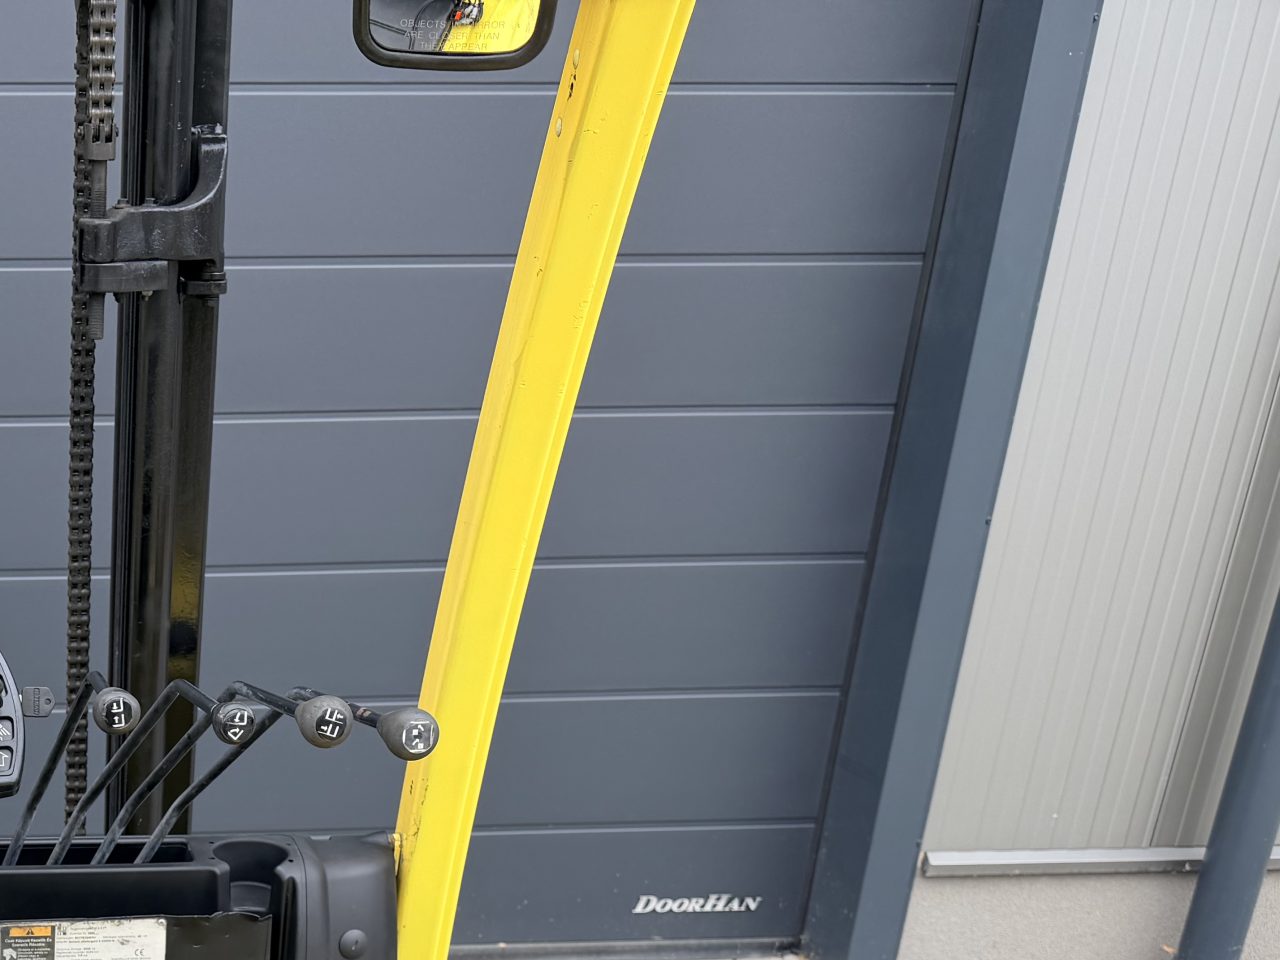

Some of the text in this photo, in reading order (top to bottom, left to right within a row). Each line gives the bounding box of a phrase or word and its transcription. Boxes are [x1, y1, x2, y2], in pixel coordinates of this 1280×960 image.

[400, 19, 446, 28] OBJECTS
[404, 31, 423, 39] ARE
[475, 32, 500, 41] THAN
[448, 42, 488, 51] APPEAR
